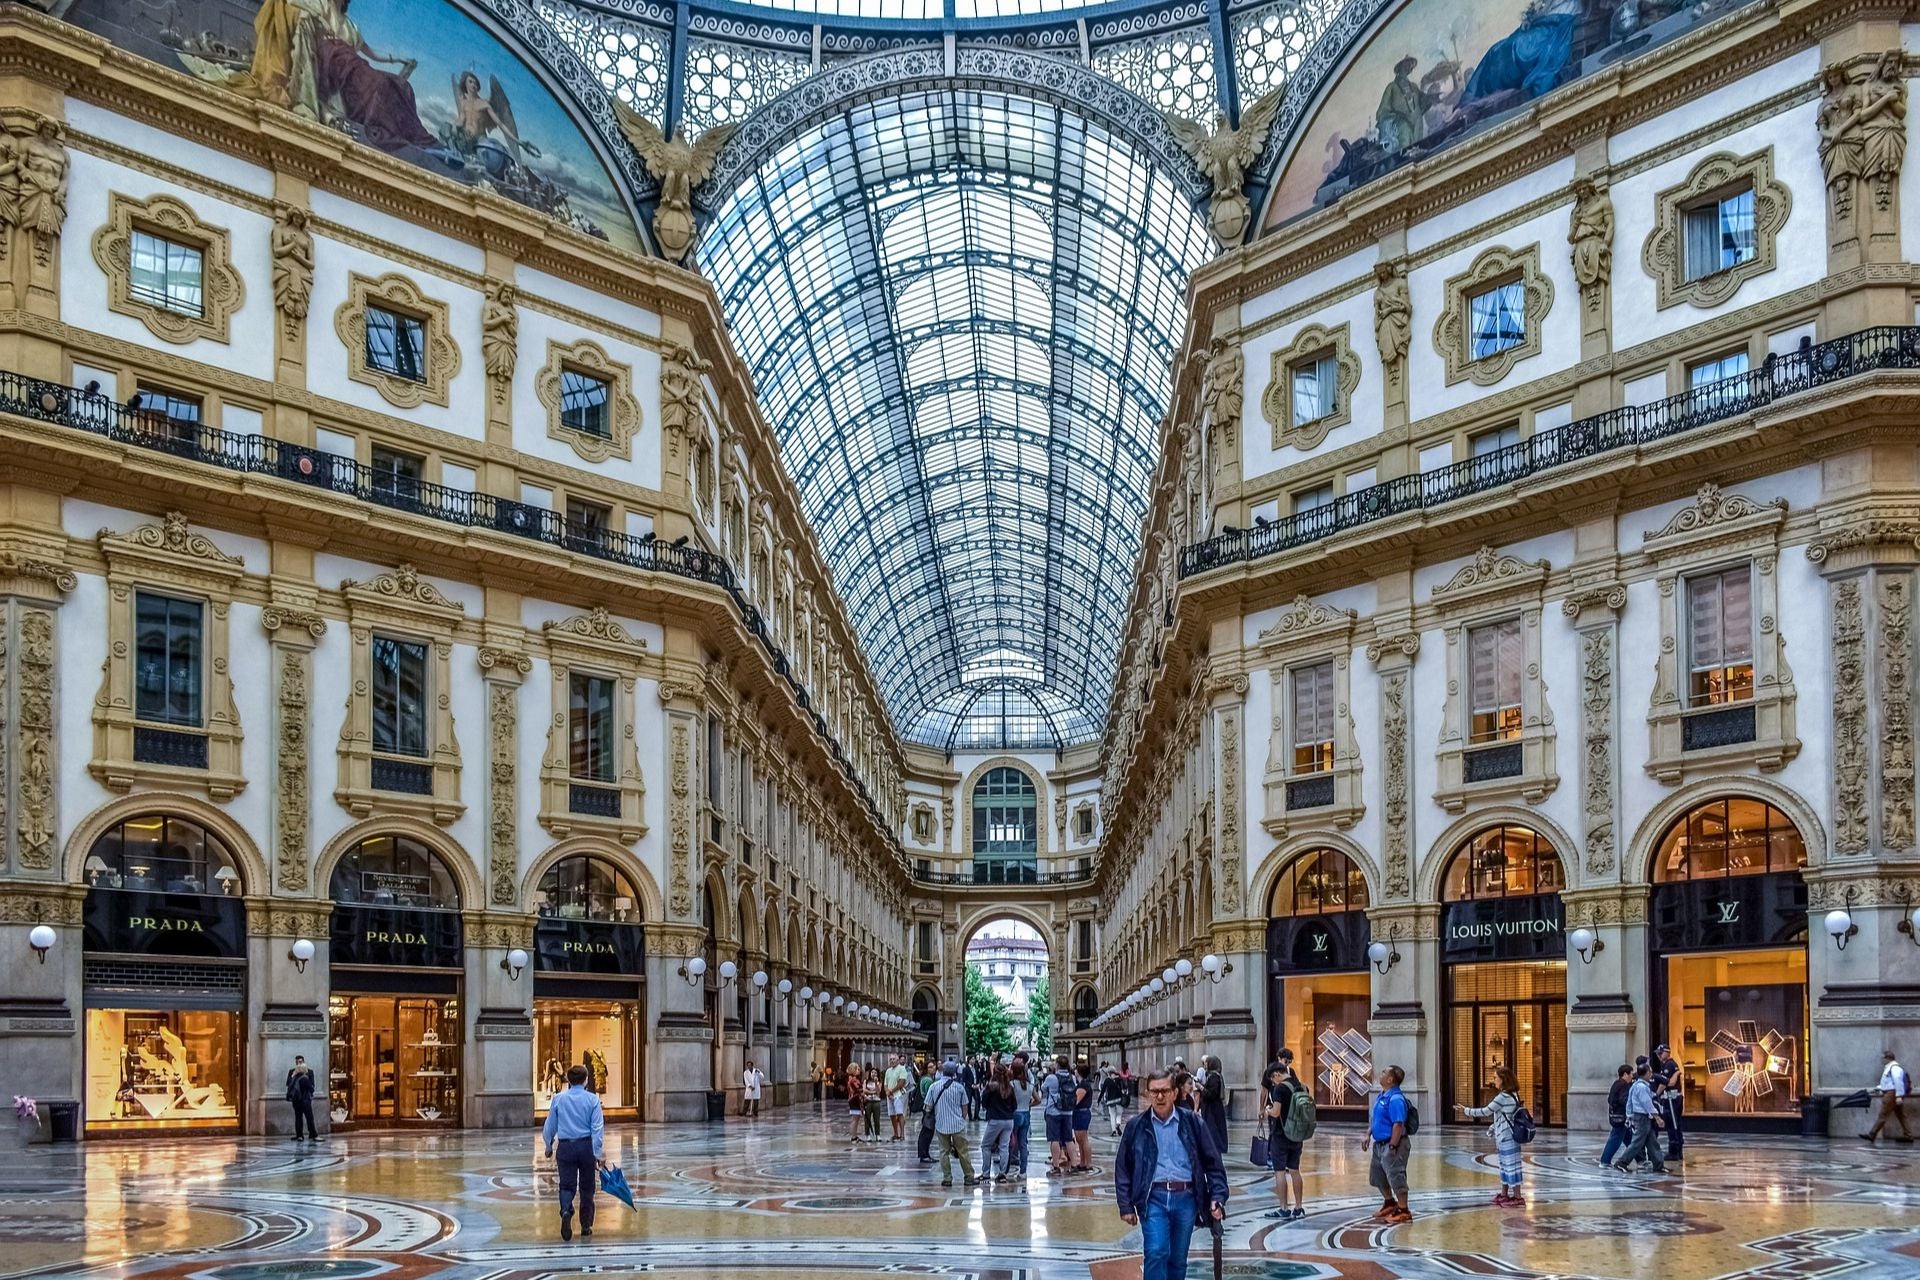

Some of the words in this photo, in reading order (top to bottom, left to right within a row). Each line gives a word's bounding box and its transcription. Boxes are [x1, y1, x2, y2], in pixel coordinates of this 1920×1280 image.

[129, 917, 204, 932] PRADA
[1452, 923, 1492, 939] LOUIS
[1495, 918, 1558, 936] VUITTON
[366, 931, 428, 945] PRADA
[563, 941, 615, 954] PRADA
